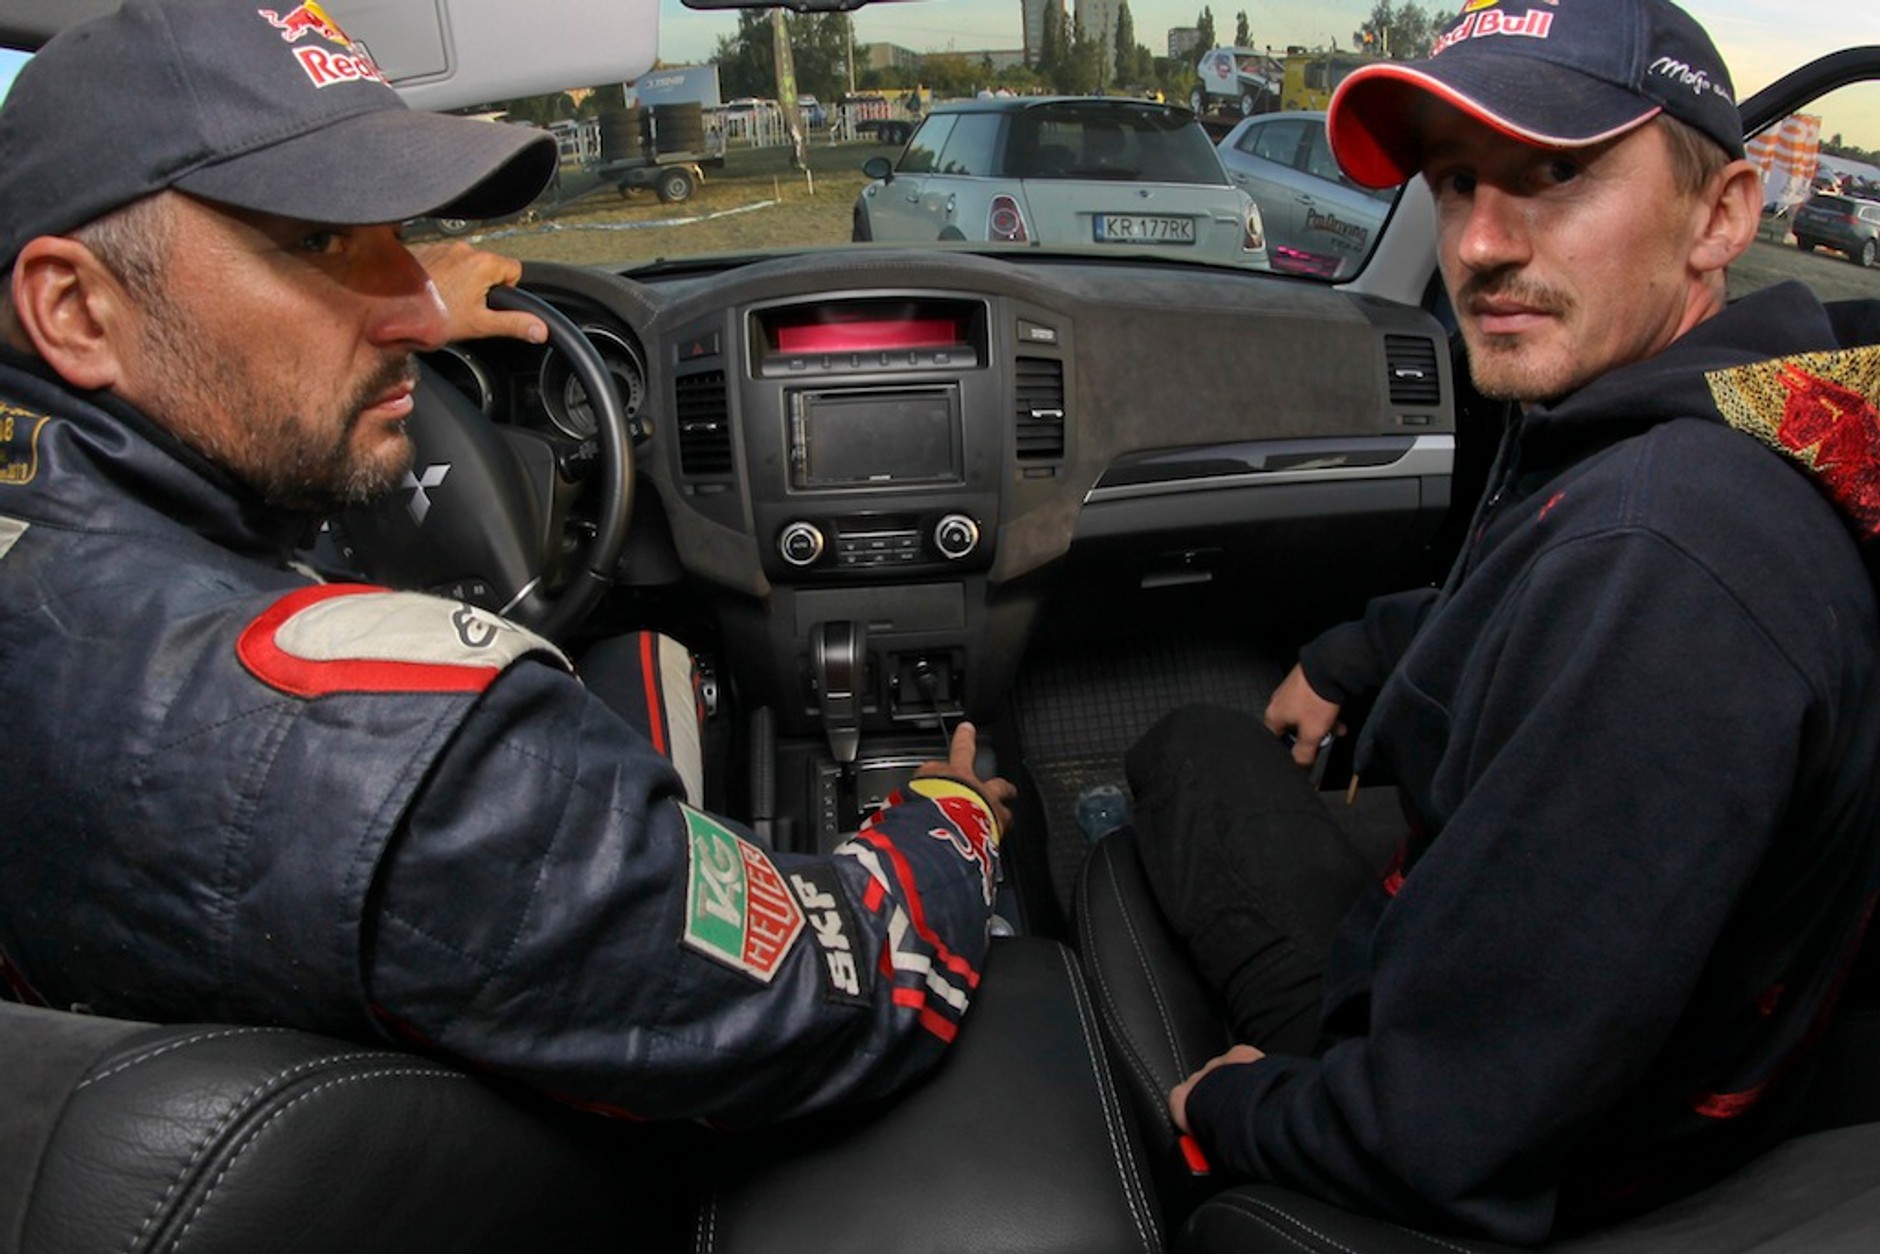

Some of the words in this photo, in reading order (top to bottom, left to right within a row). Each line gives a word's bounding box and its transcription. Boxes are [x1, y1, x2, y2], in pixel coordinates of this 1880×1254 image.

[1473, 9, 1553, 38] Bull
[1106, 218, 1133, 237] KR
[1140, 219, 1191, 239] 177RK
[695, 833, 743, 929] TAG
[746, 844, 794, 966] HEUER
[790, 874, 860, 996] SKF
